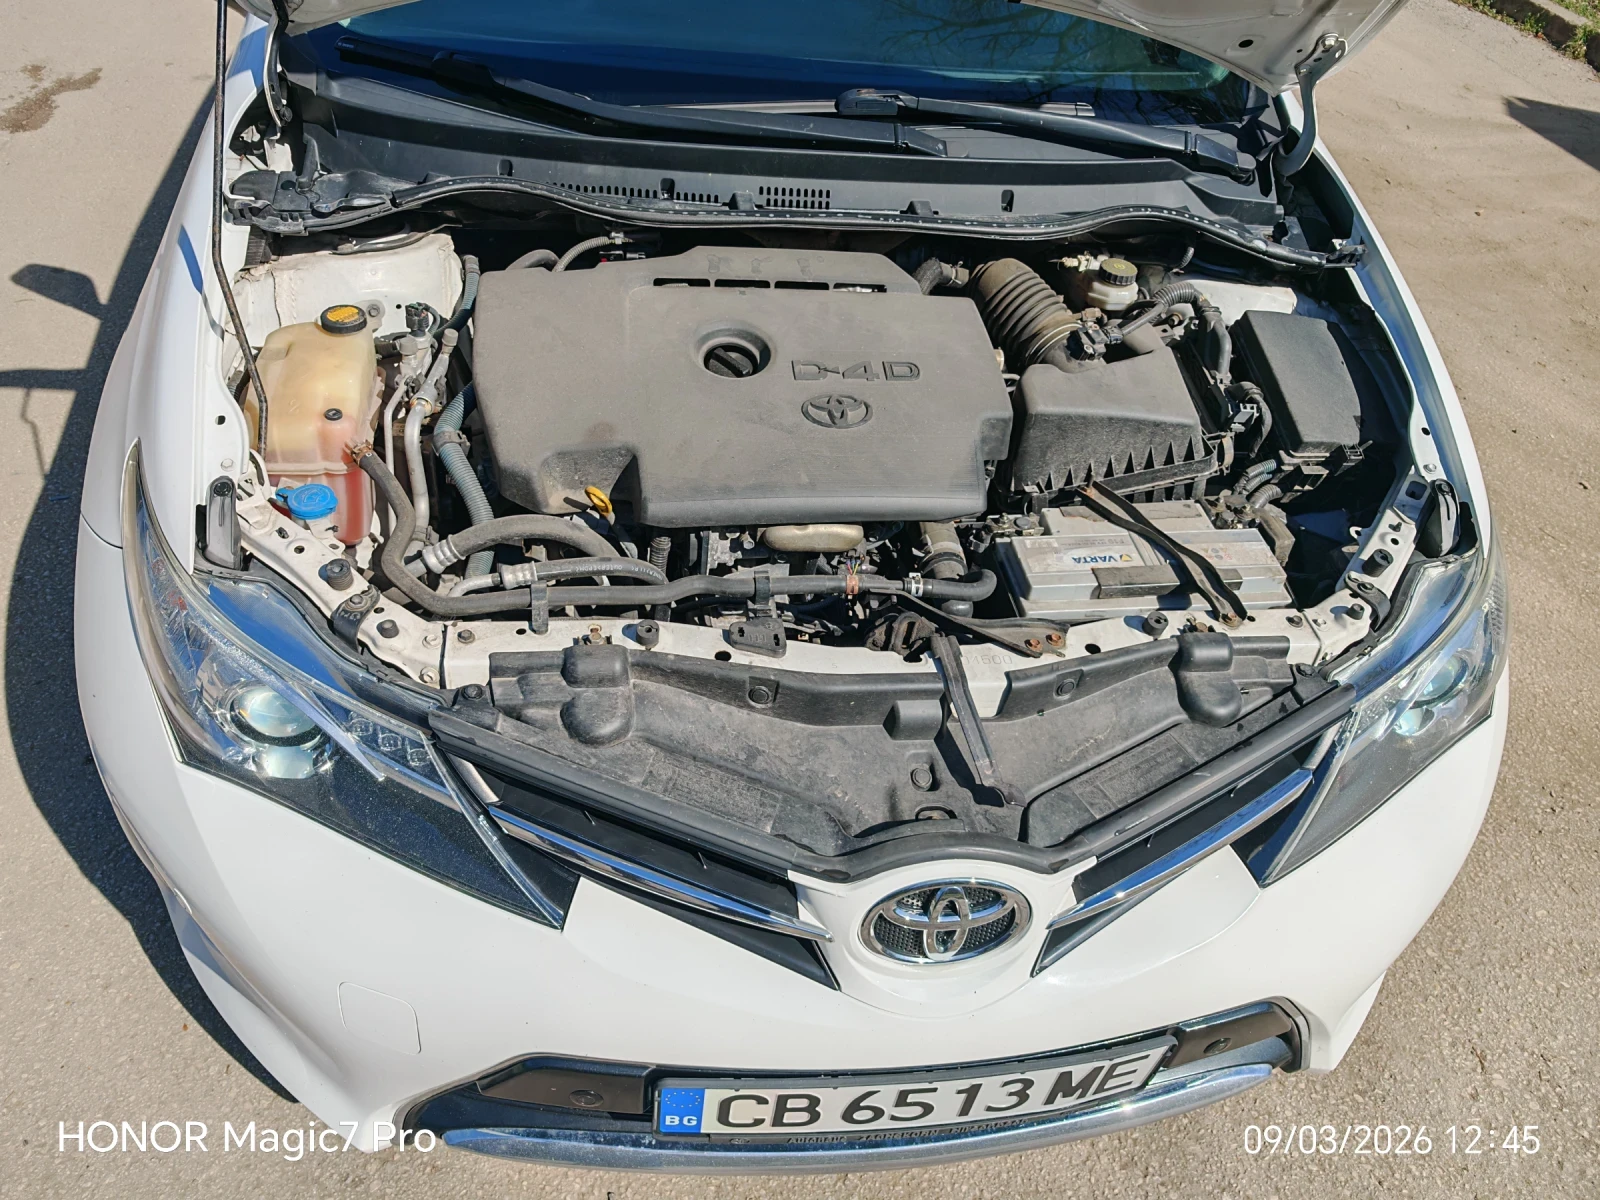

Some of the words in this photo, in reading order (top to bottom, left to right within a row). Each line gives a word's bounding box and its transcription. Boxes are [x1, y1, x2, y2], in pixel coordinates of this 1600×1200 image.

[791, 360, 921, 382] D-4D
[1071, 554, 1119, 564] VARTA
[716, 1093, 822, 1128] CB
[841, 1078, 1035, 1124] 6513
[1042, 1053, 1152, 1107] ME
[665, 1115, 698, 1128] BG
